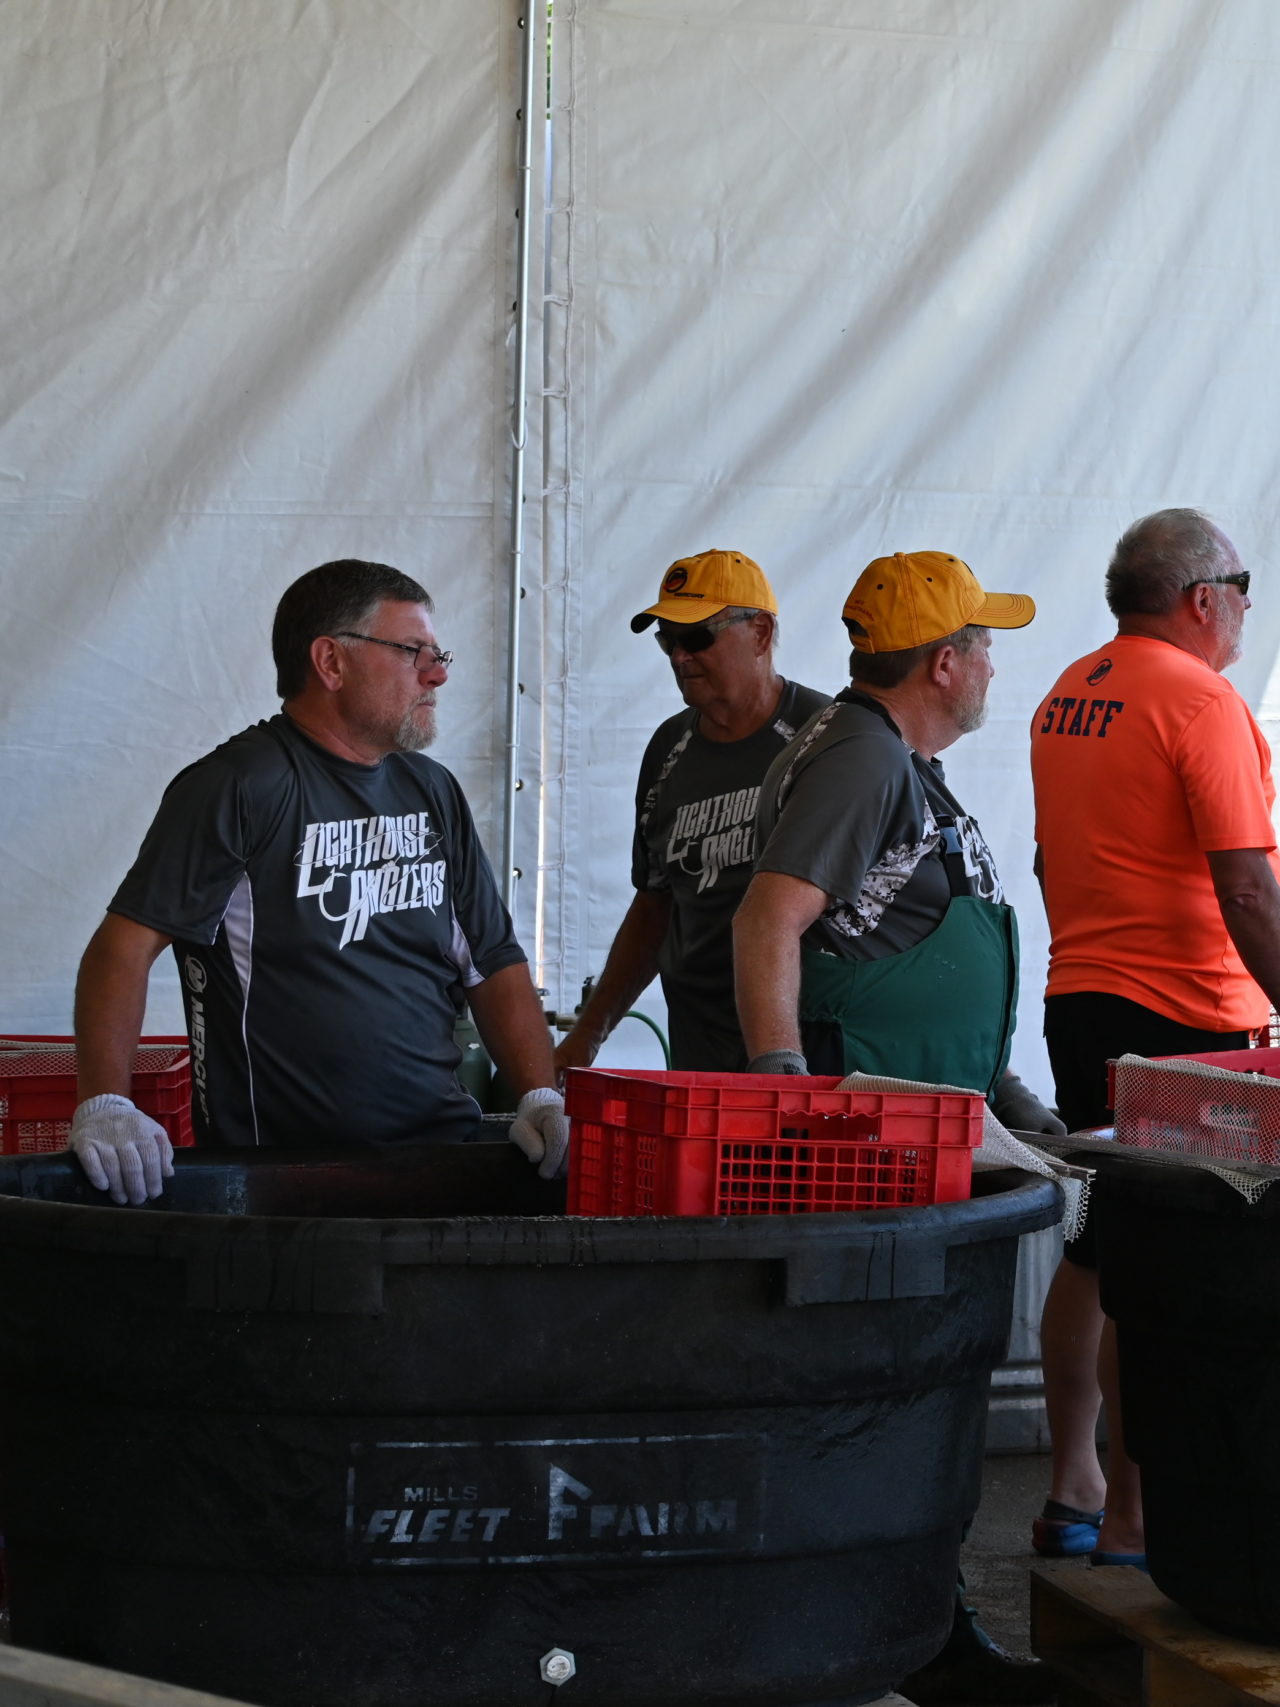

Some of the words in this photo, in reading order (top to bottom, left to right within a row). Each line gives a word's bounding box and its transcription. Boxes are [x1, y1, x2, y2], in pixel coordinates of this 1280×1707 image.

[1041, 697, 1125, 738] STAFF
[297, 812, 431, 898] LIGHTHOUSE
[666, 785, 761, 864] LIGHTHOU
[339, 860, 447, 951] ANGLERS
[363, 1508, 511, 1543] FLEET
[590, 1500, 738, 1538] FARM
[403, 1485, 478, 1503] MILLS
